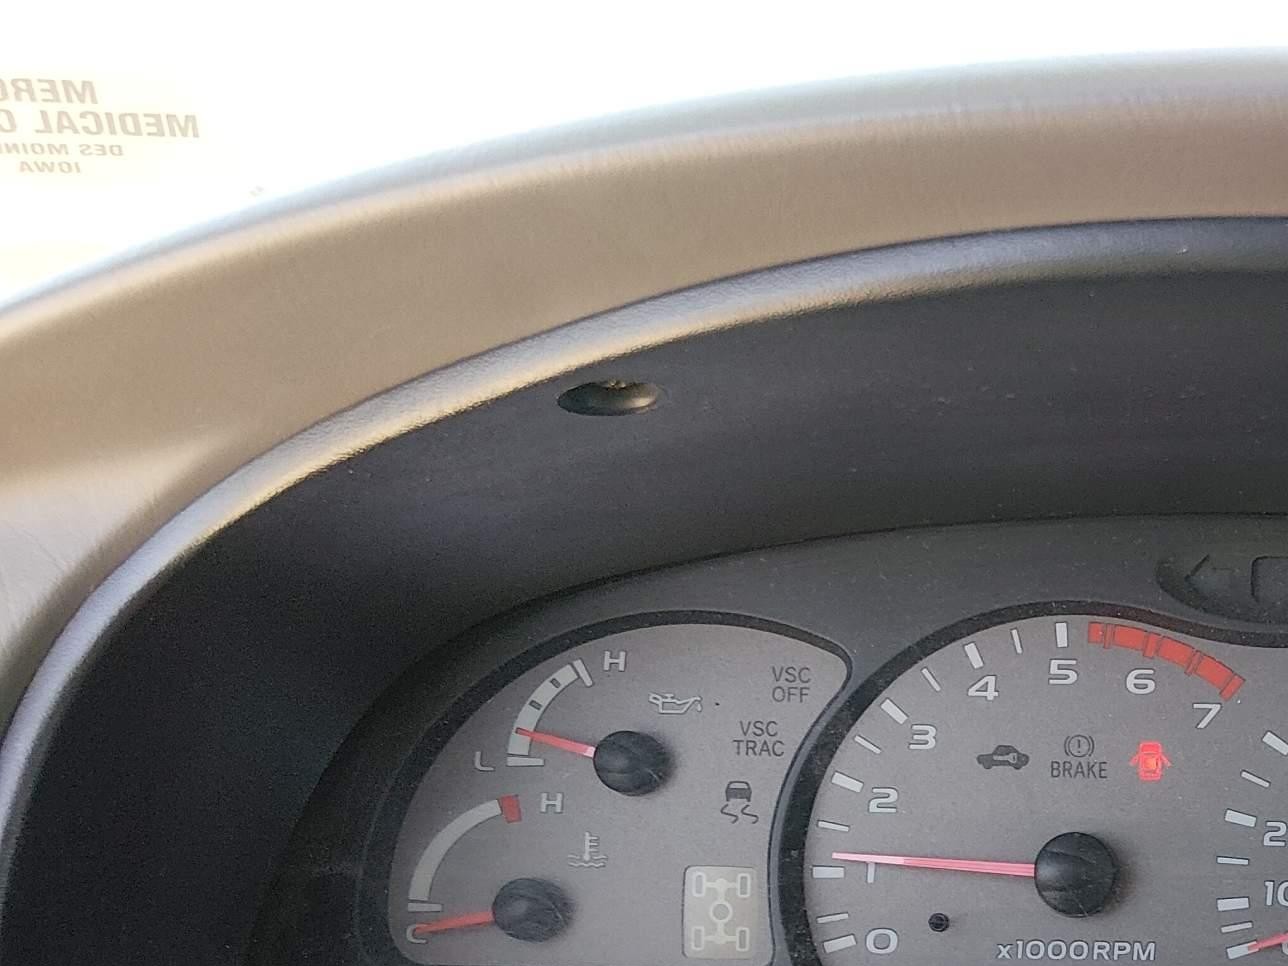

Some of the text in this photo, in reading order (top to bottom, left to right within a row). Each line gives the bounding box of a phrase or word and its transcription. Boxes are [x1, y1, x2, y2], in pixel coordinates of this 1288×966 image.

[603, 650, 626, 671] H
[772, 667, 811, 683] VSC
[1048, 659, 1078, 685] 5
[1125, 668, 1156, 694] 6
[772, 686, 810, 702] OFF
[967, 675, 999, 700] 4
[1192, 703, 1222, 728] 7
[739, 721, 778, 736] VSC
[909, 724, 937, 750] 3
[732, 740, 785, 757] TRAC
[475, 751, 495, 772] L
[1050, 761, 1108, 779] BRAKE
[540, 793, 563, 813] H
[868, 786, 899, 813] 2
[865, 928, 898, 954] 0
